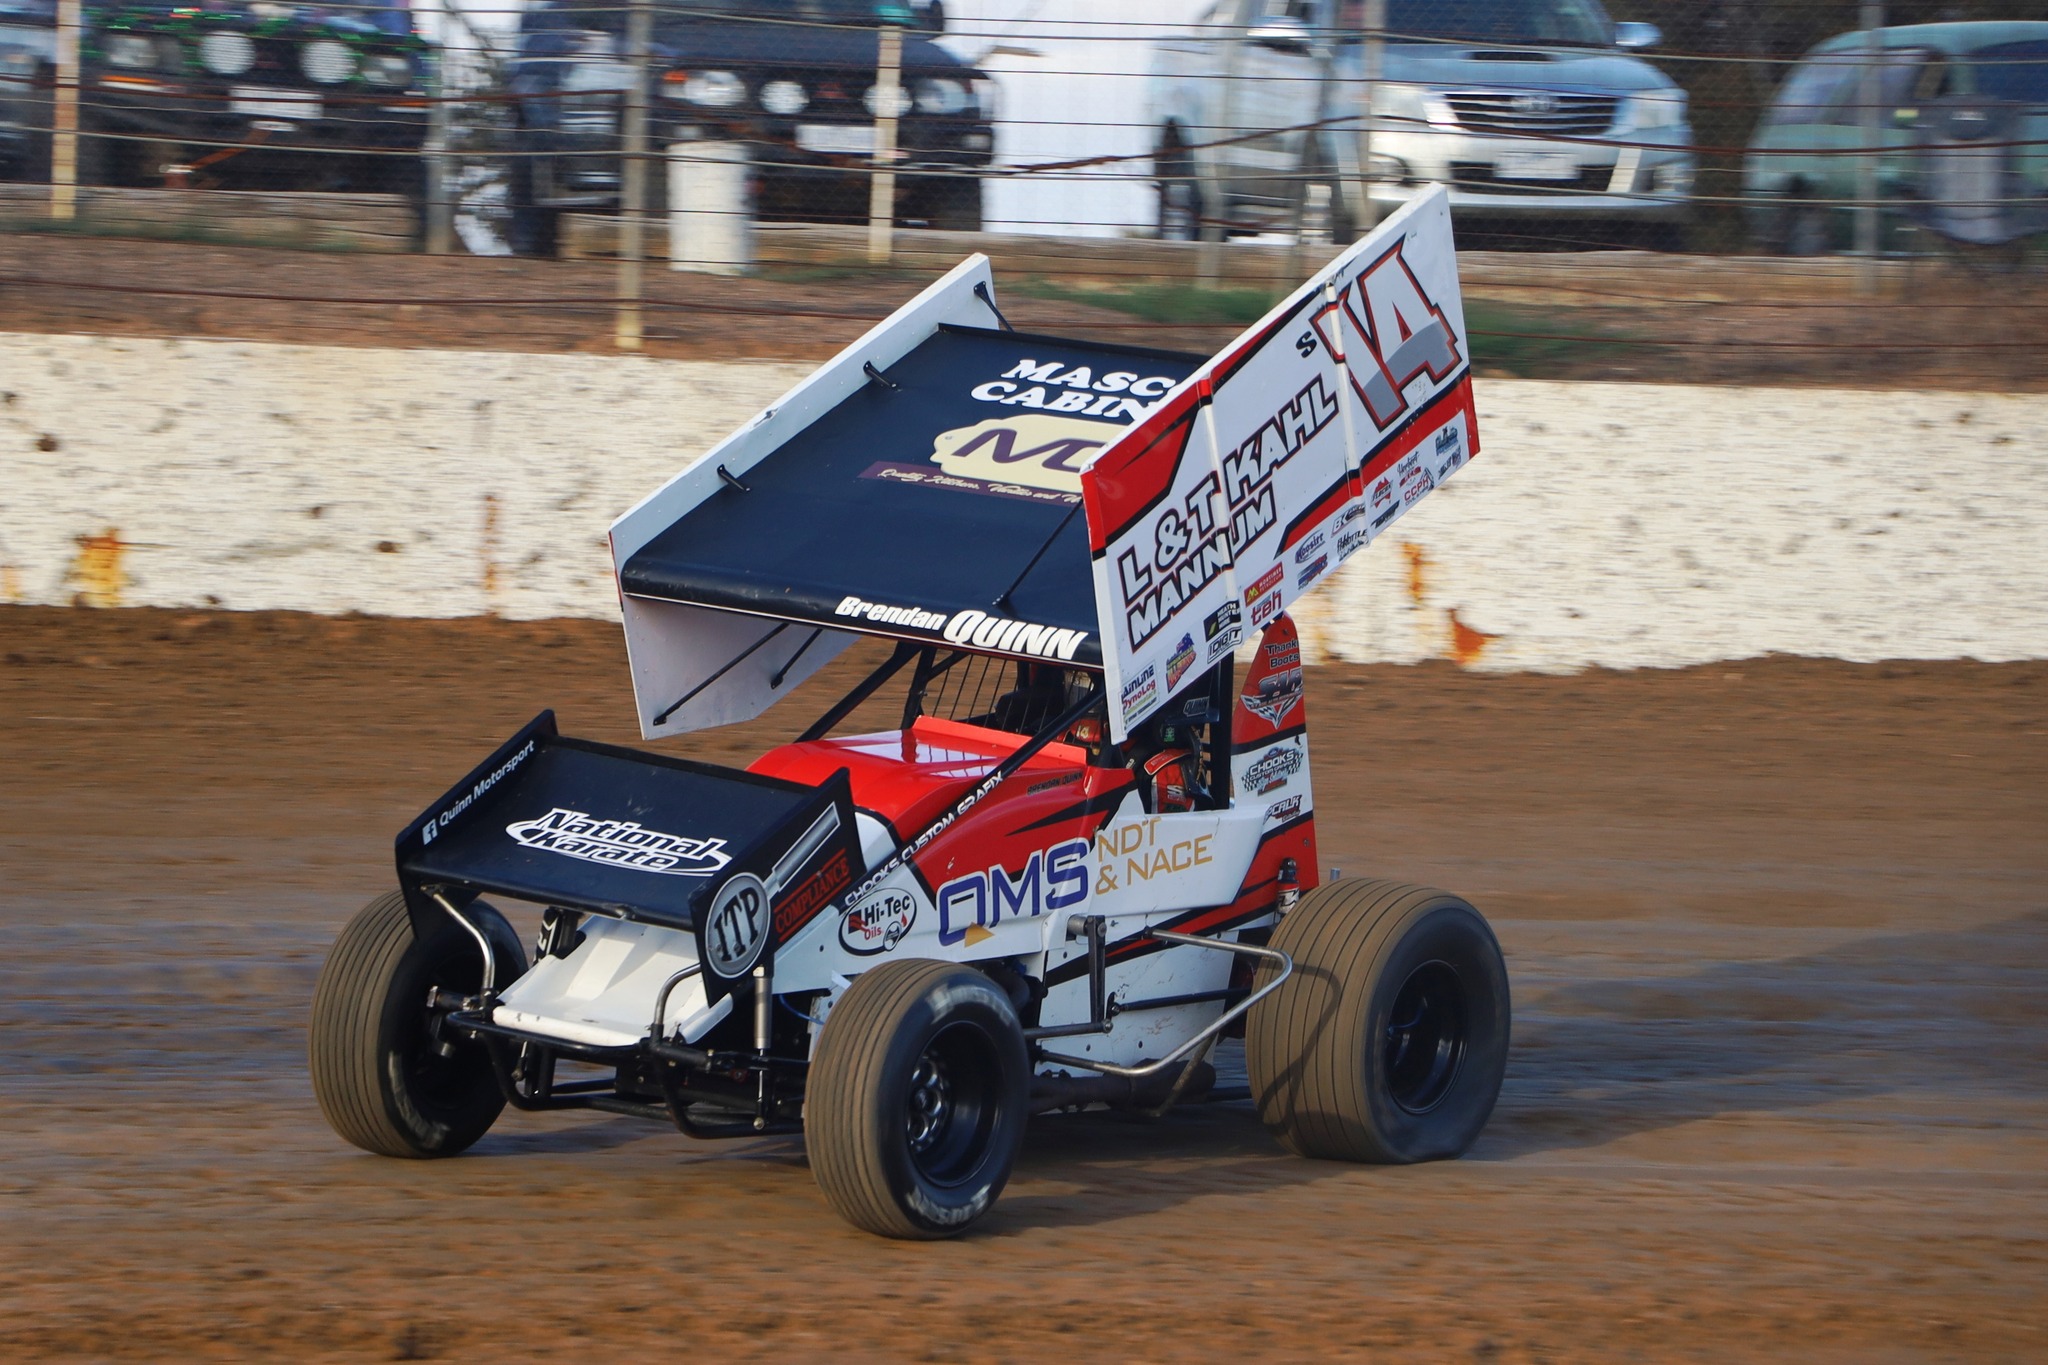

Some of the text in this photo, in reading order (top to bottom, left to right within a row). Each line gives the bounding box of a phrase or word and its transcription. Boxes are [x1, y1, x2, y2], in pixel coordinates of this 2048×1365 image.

[1222, 372, 1340, 510] KAHL
[1404, 475, 1430, 501] CCPH
[1126, 480, 1277, 654] MANNUM
[835, 596, 1089, 660] Brendan QUINN
[439, 795, 472, 828] Quinn
[473, 740, 534, 800] Motorsport
[1249, 750, 1295, 775] CHOOKS
[519, 828, 680, 872] Karate
[533, 808, 728, 860] National
[845, 771, 1004, 907] CHOOKS CUSTOM GRAFIX
[1097, 817, 1161, 862] NDT
[1095, 834, 1213, 895] & NACE
[774, 856, 850, 934] COMPLIANCE
[864, 895, 910, 927] Hi-Tec
[864, 926, 882, 940] Oils
